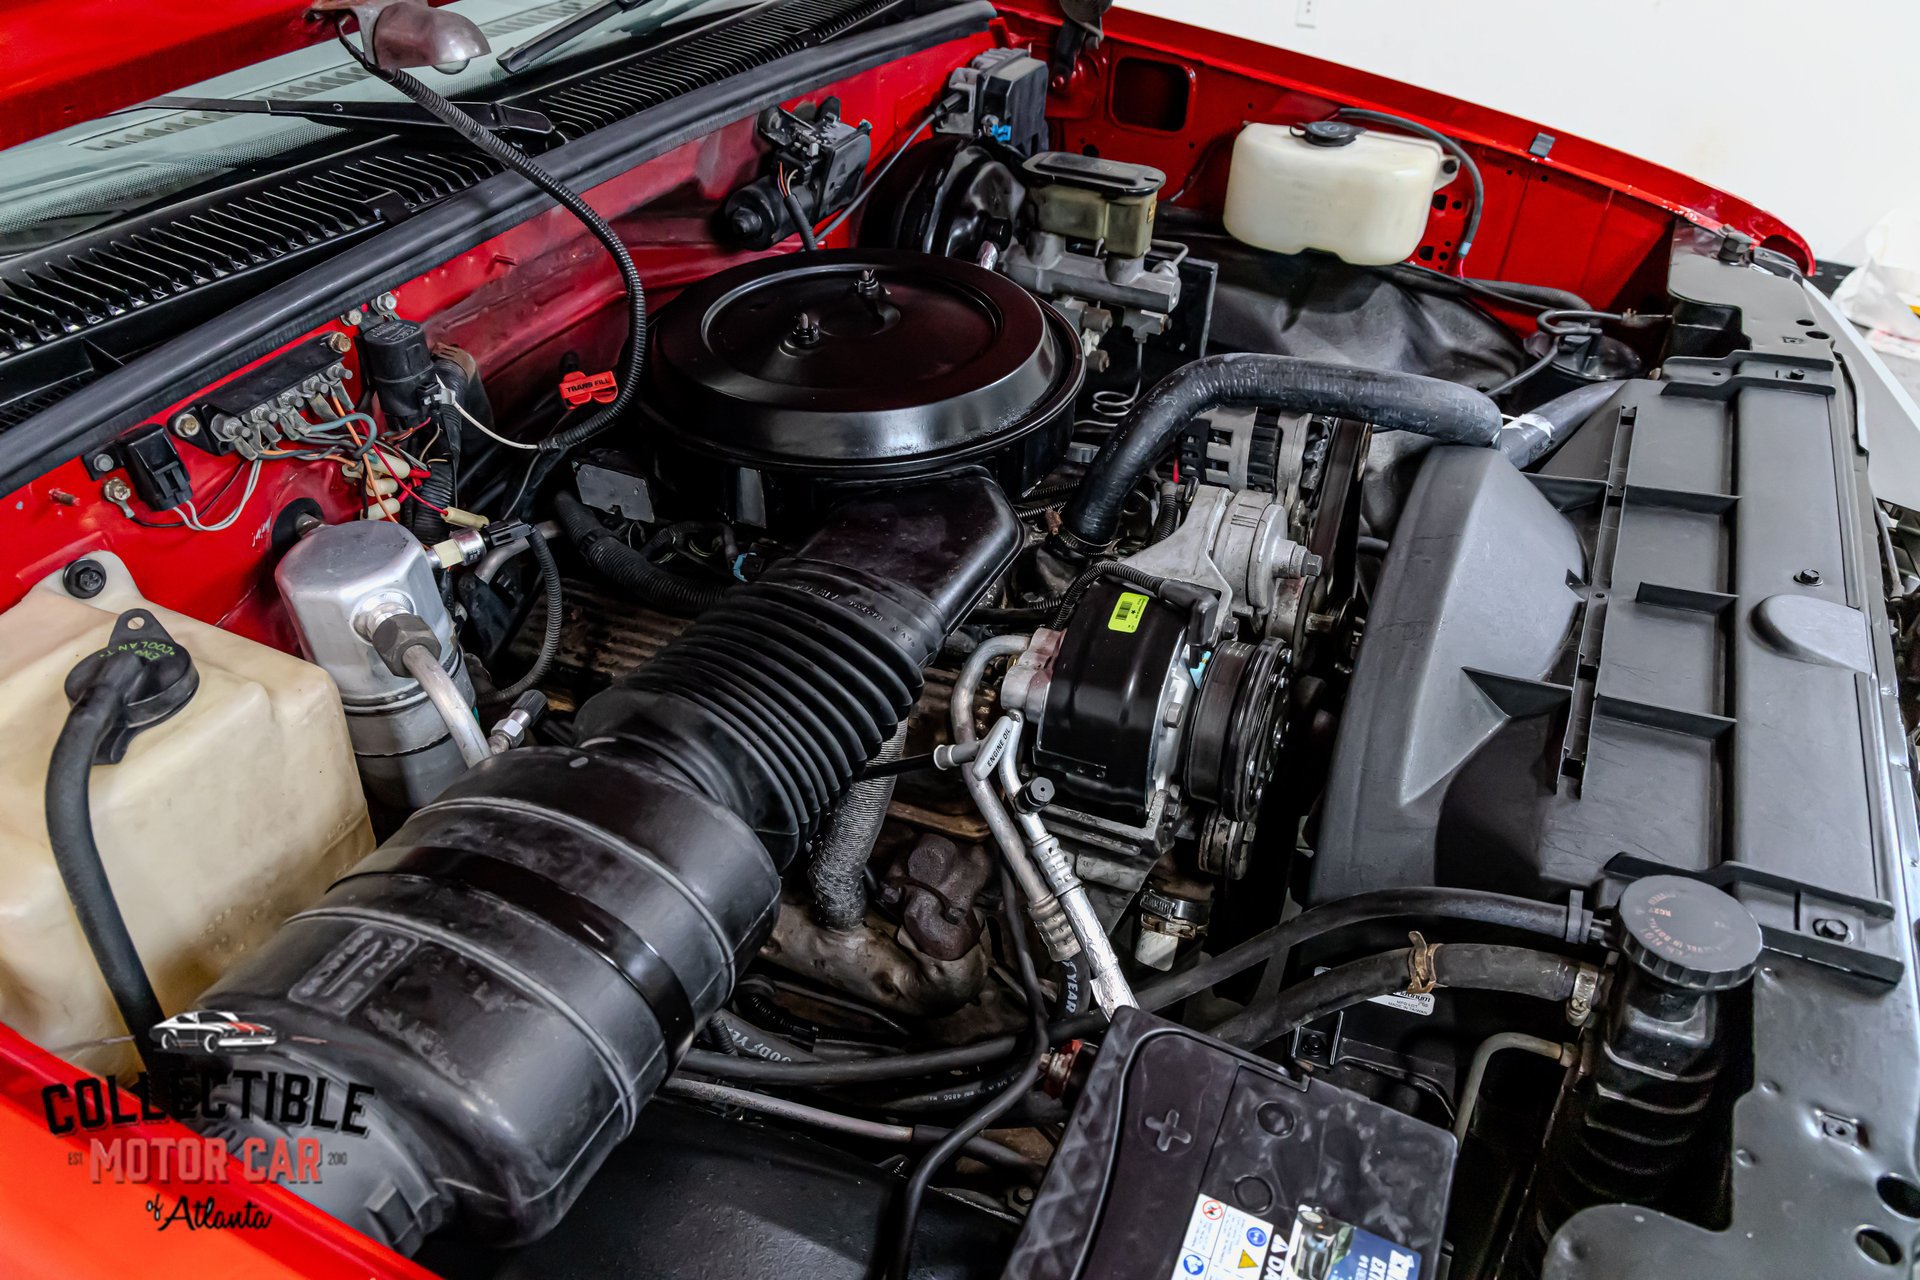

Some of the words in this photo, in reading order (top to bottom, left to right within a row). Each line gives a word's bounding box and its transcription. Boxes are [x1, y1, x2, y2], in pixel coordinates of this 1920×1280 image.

[567, 382, 593, 392] TRANS
[594, 378, 609, 386] FILL
[986, 740, 1005, 767] ENGINE
[1002, 728, 1011, 741] OIL
